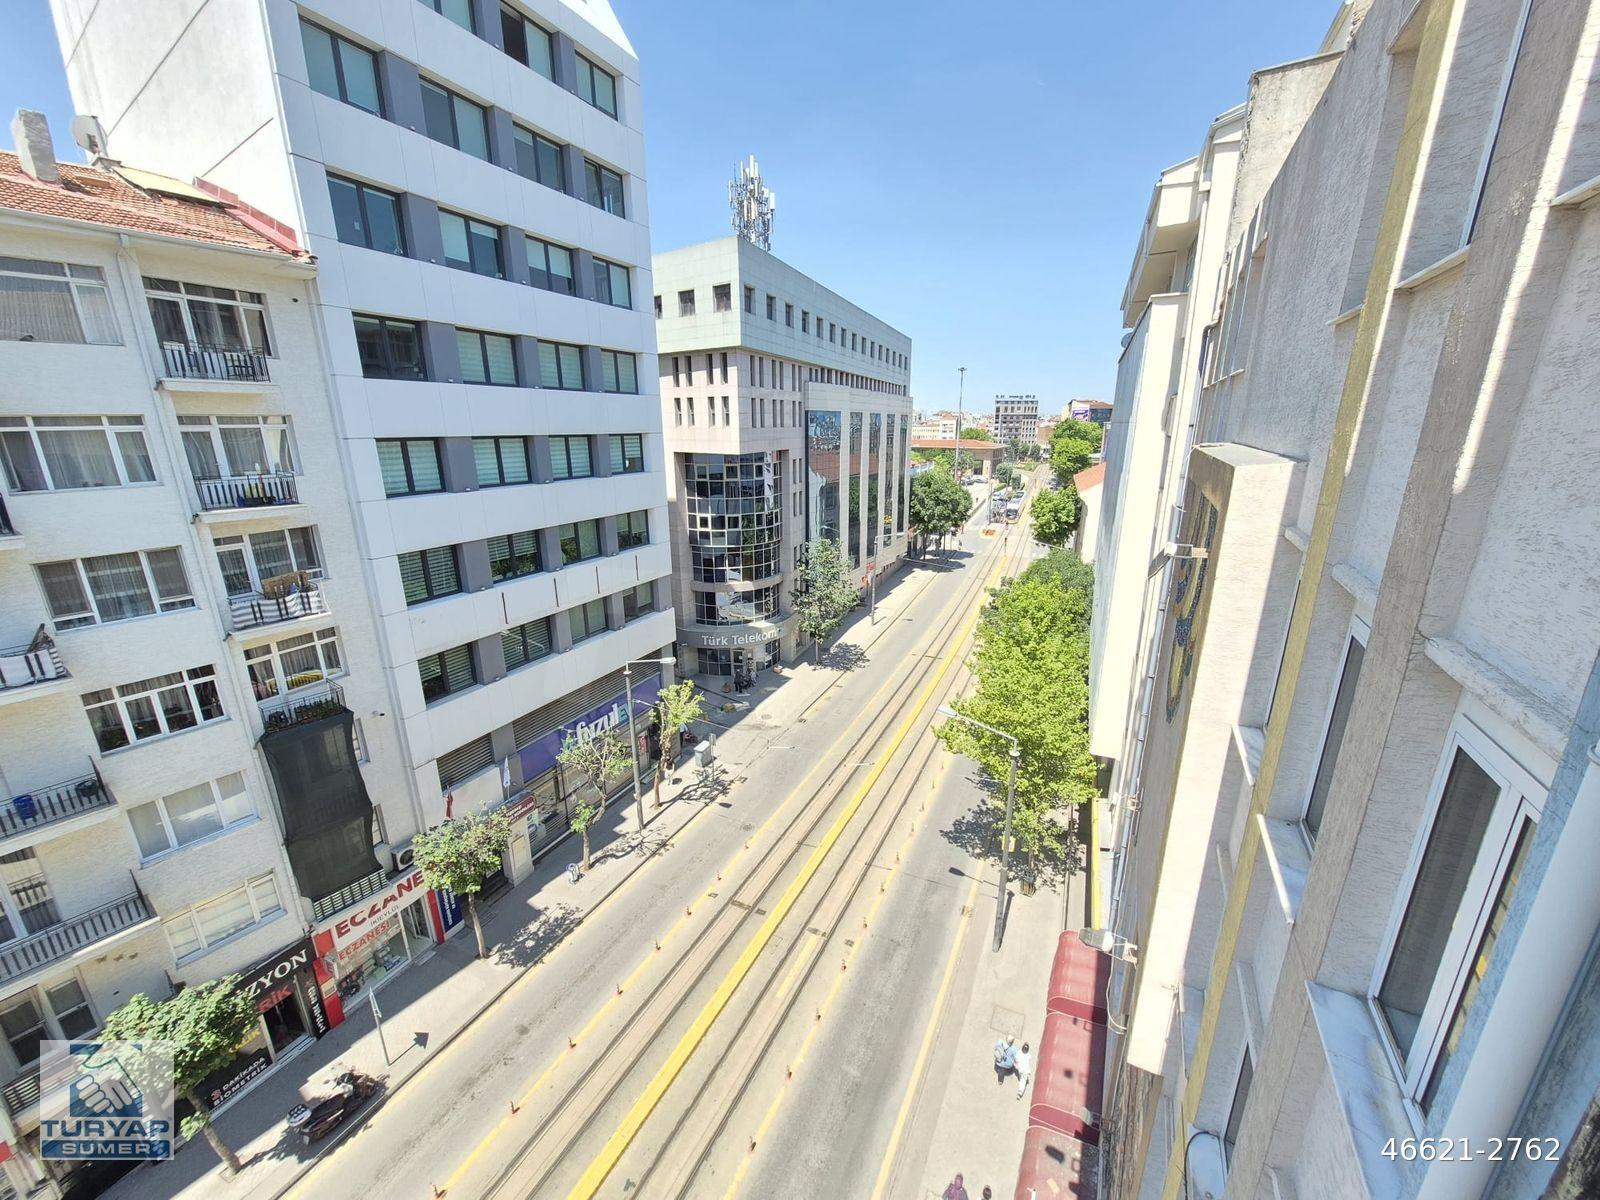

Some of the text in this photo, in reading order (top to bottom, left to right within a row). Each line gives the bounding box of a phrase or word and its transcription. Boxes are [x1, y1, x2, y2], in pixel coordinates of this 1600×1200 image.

[701, 629, 777, 646] Türk Telekom
[334, 869, 425, 939] ECZANE
